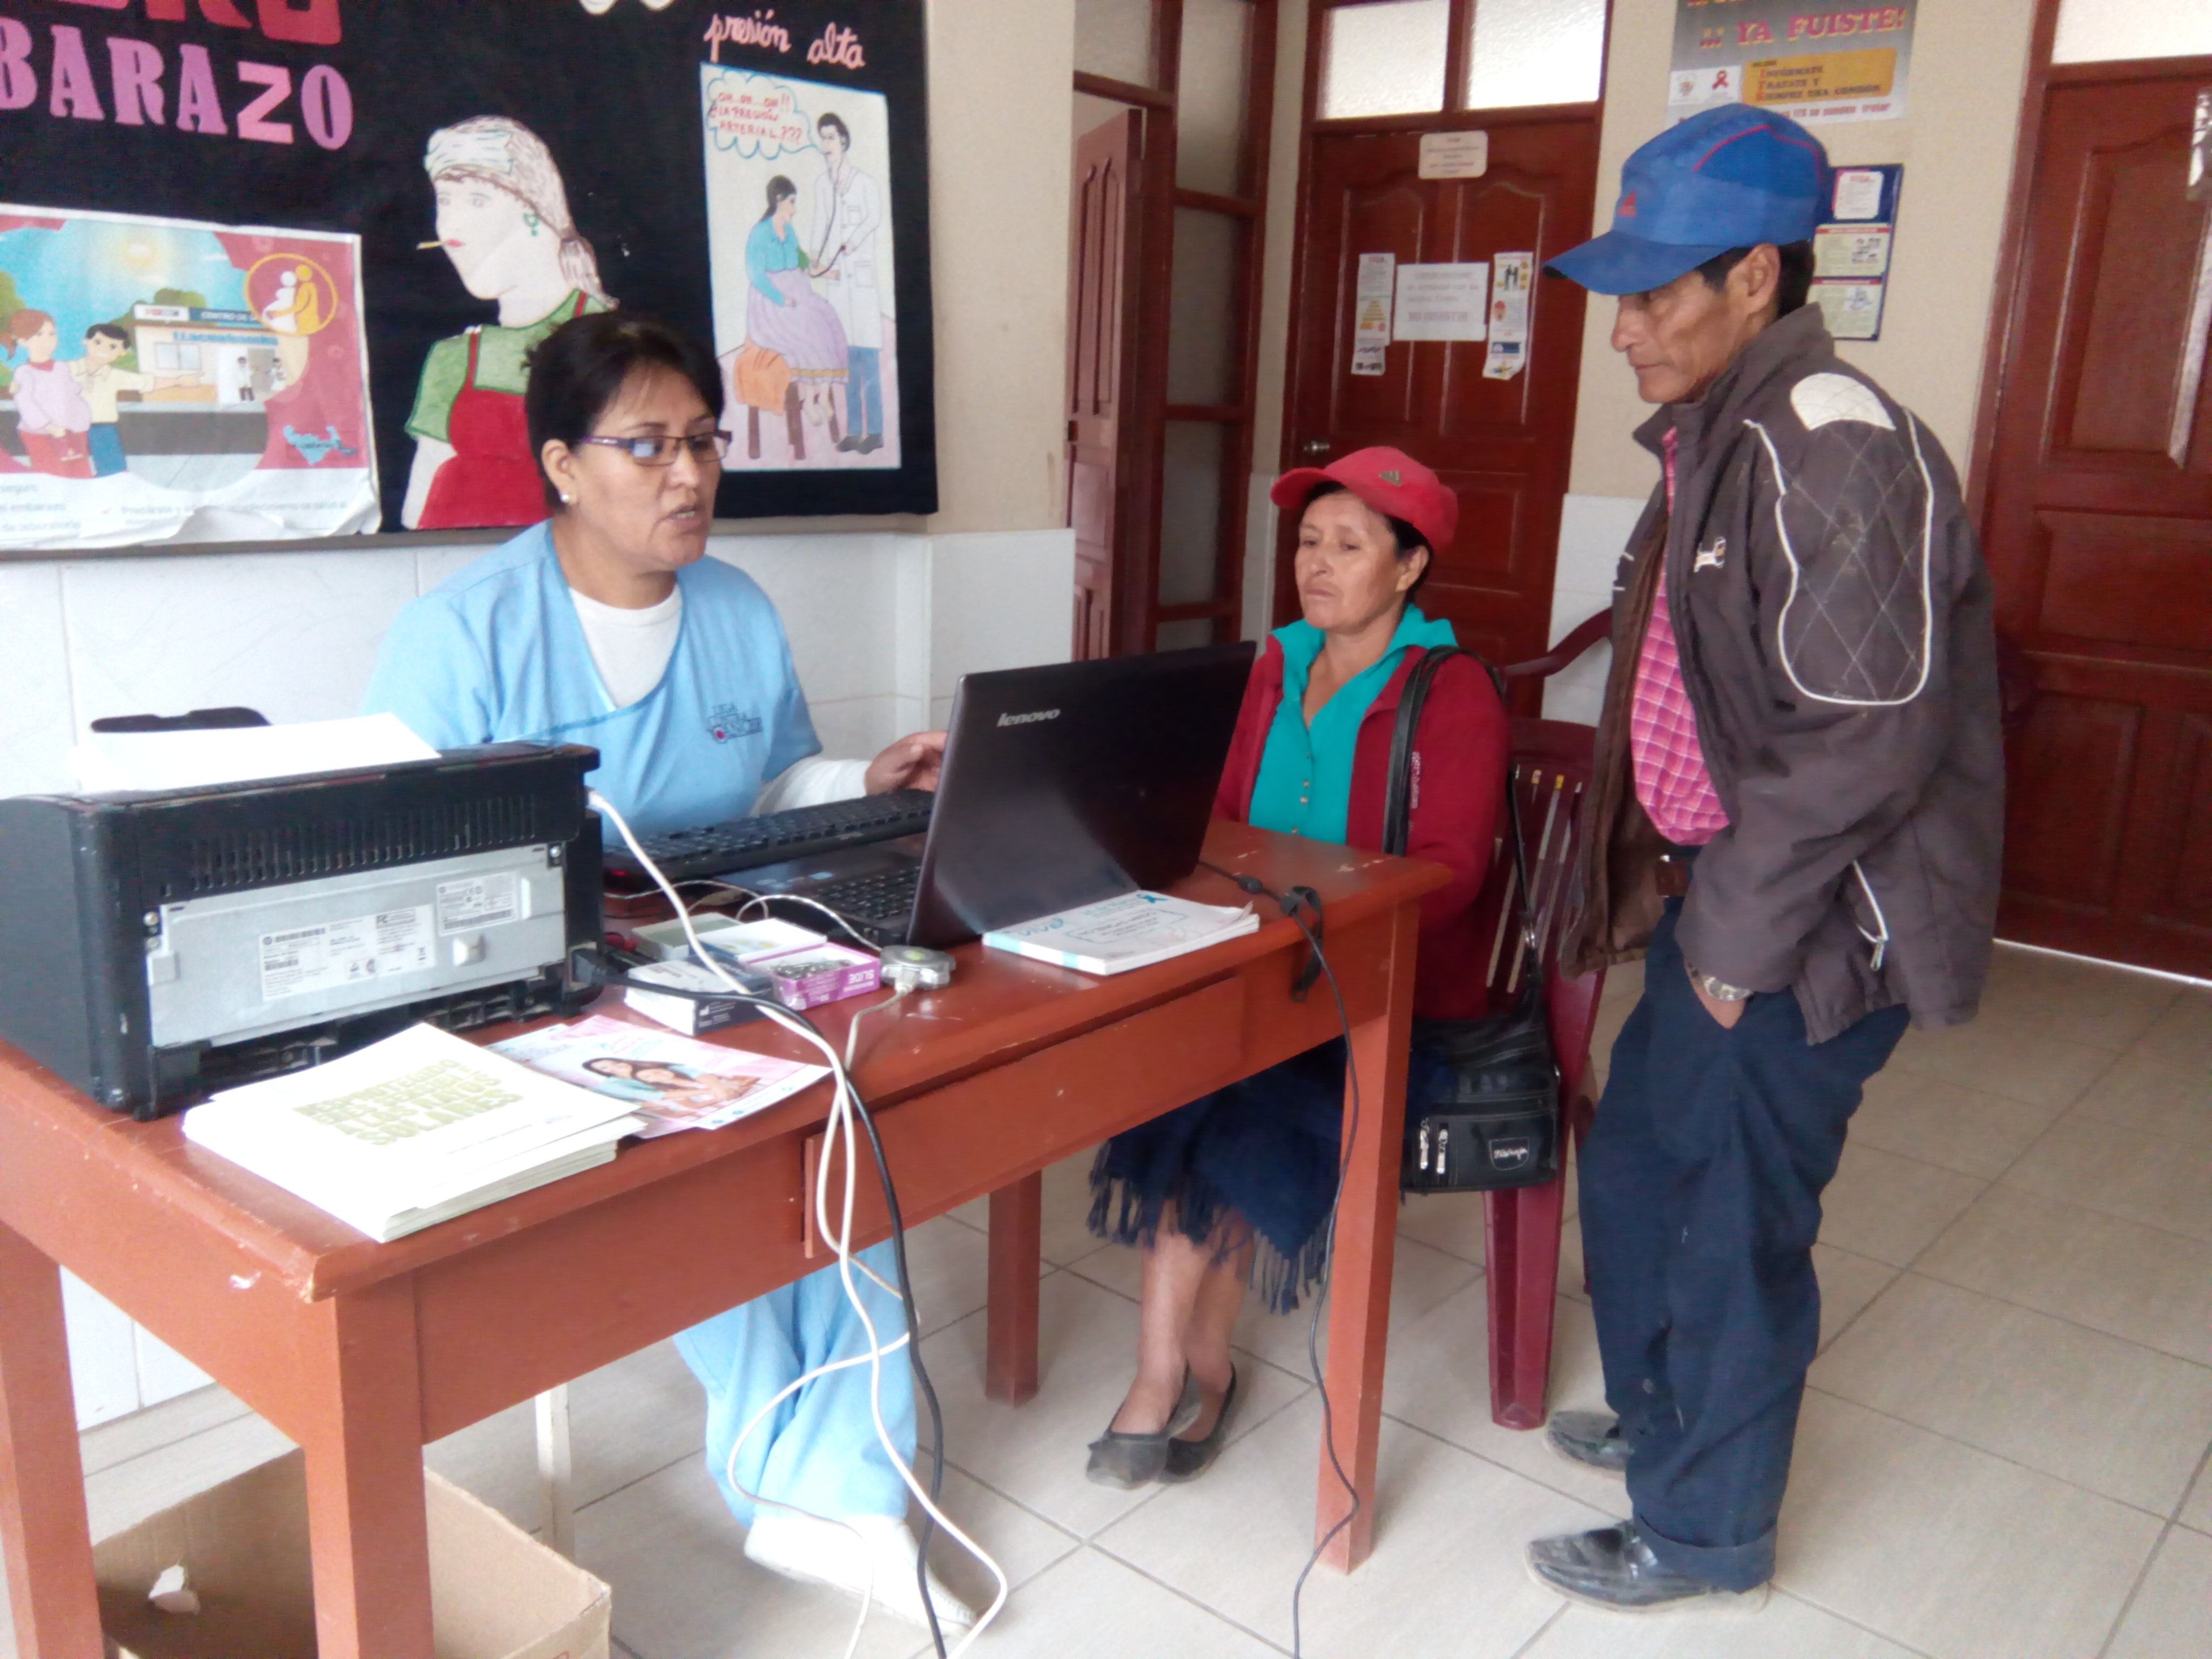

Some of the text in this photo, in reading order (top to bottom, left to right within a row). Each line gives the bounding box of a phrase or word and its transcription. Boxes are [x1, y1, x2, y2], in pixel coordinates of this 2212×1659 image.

[704, 10, 866, 69] presión alta
[1735, 20, 1775, 47] YA
[996, 708, 1061, 727] lenovo
[356, 1088, 524, 1146] SOLARES
